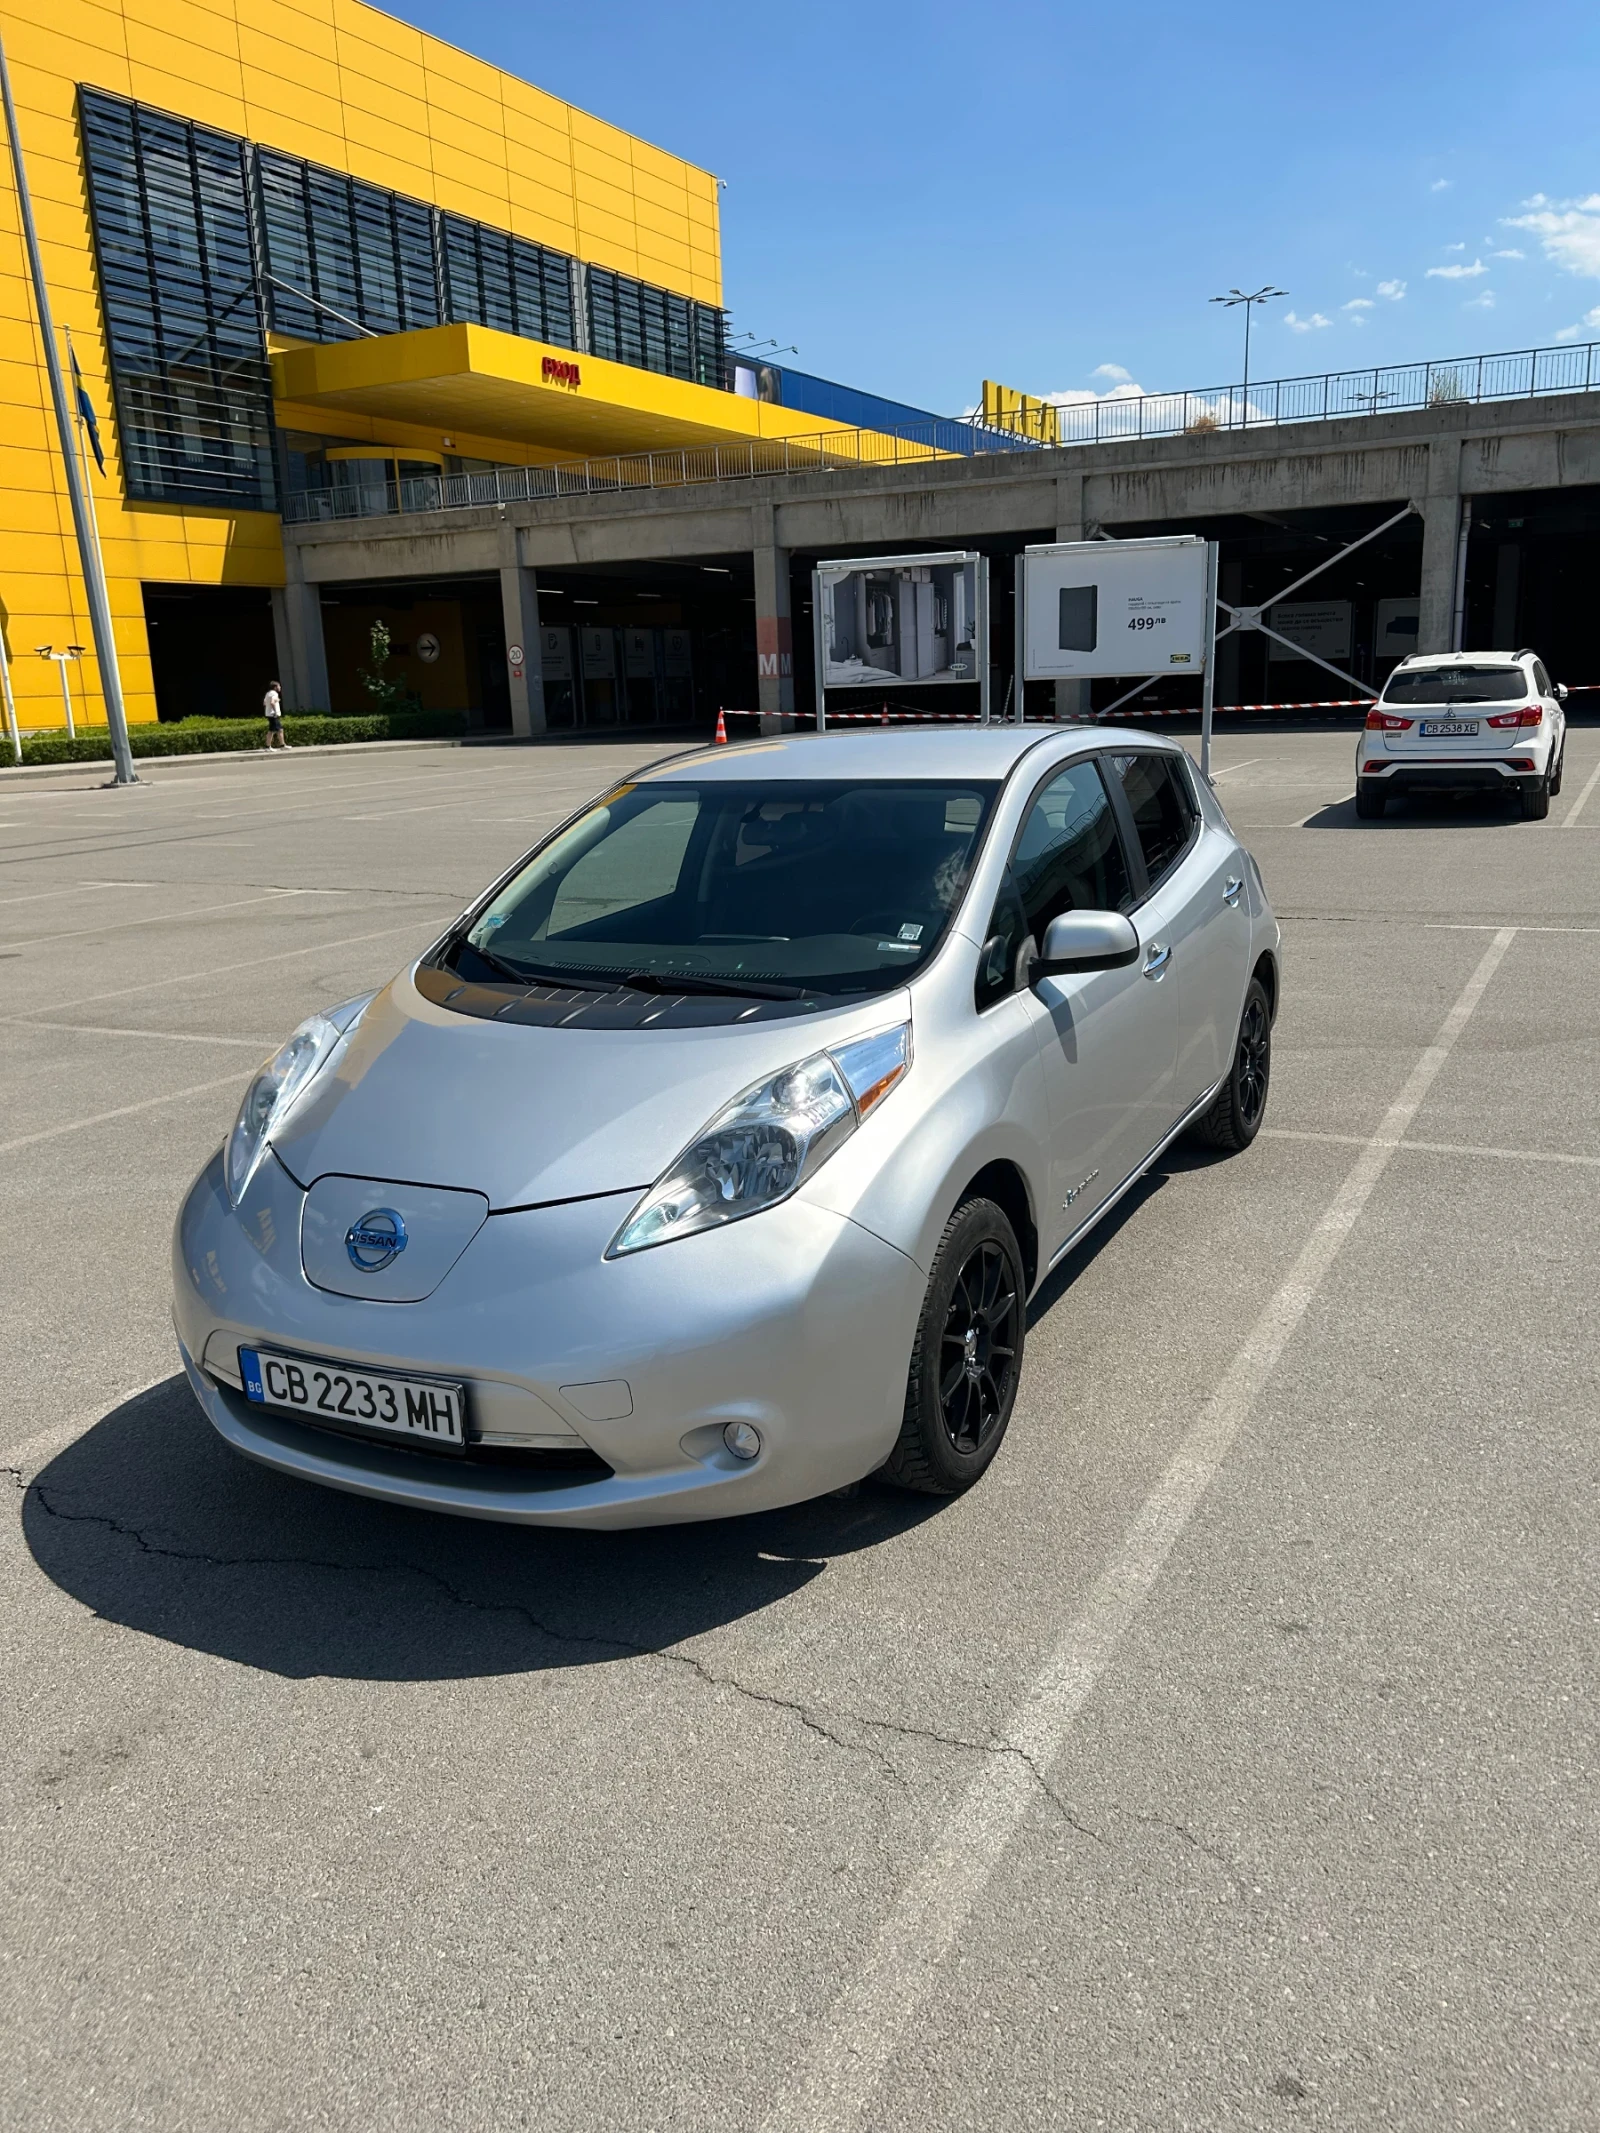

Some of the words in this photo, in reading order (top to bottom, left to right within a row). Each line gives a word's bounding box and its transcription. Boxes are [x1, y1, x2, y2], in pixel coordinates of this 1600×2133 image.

[541, 356, 581, 386] ВХОД
[982, 379, 1062, 447] IKEA
[511, 649, 522, 660] 20
[758, 653, 778, 676] M
[781, 653, 791, 675] M
[1426, 724, 1438, 733] CB
[1440, 724, 1462, 733] 2538
[1464, 723, 1477, 732] XE
[349, 1231, 397, 1248] NISSAN
[247, 1380, 262, 1394] BG
[265, 1361, 309, 1404] CB
[313, 1372, 399, 1423] 2233
[404, 1387, 455, 1436] MH
